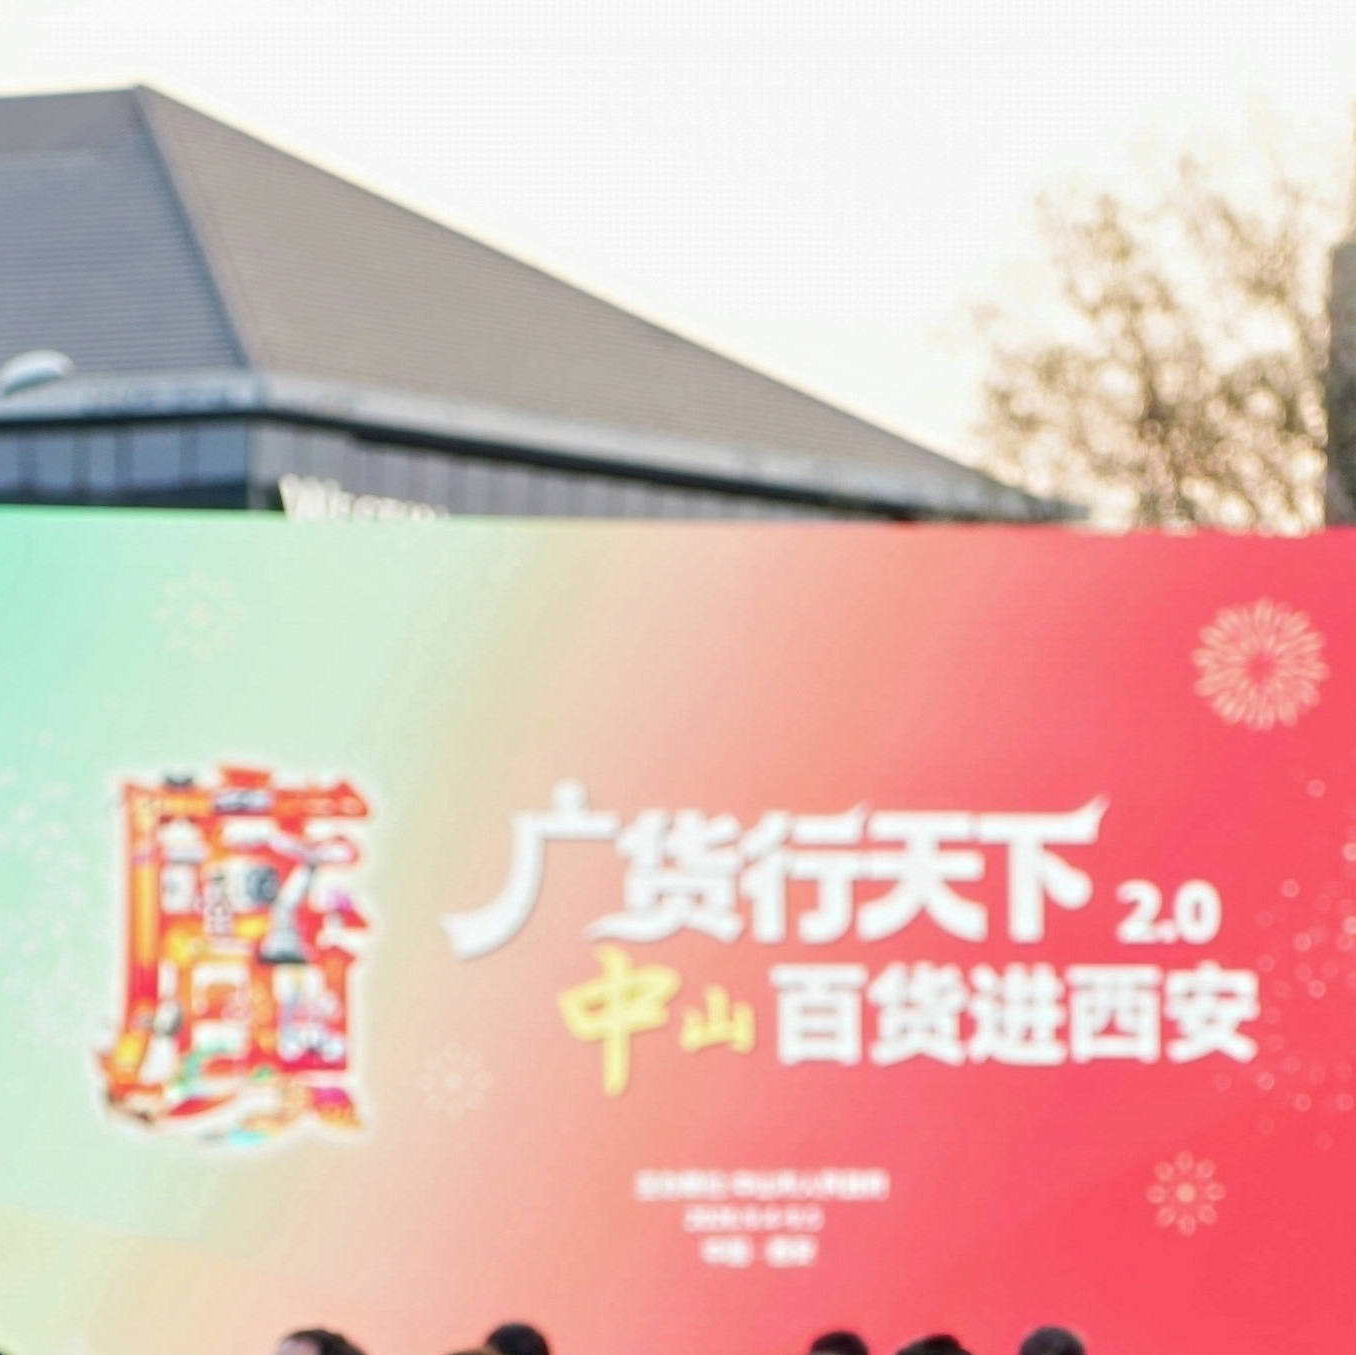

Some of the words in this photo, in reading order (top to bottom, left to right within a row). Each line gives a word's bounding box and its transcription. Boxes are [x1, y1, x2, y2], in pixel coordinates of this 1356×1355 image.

[440, 778, 1111, 961] 广货行天下
[1116, 878, 1223, 946] 2.0
